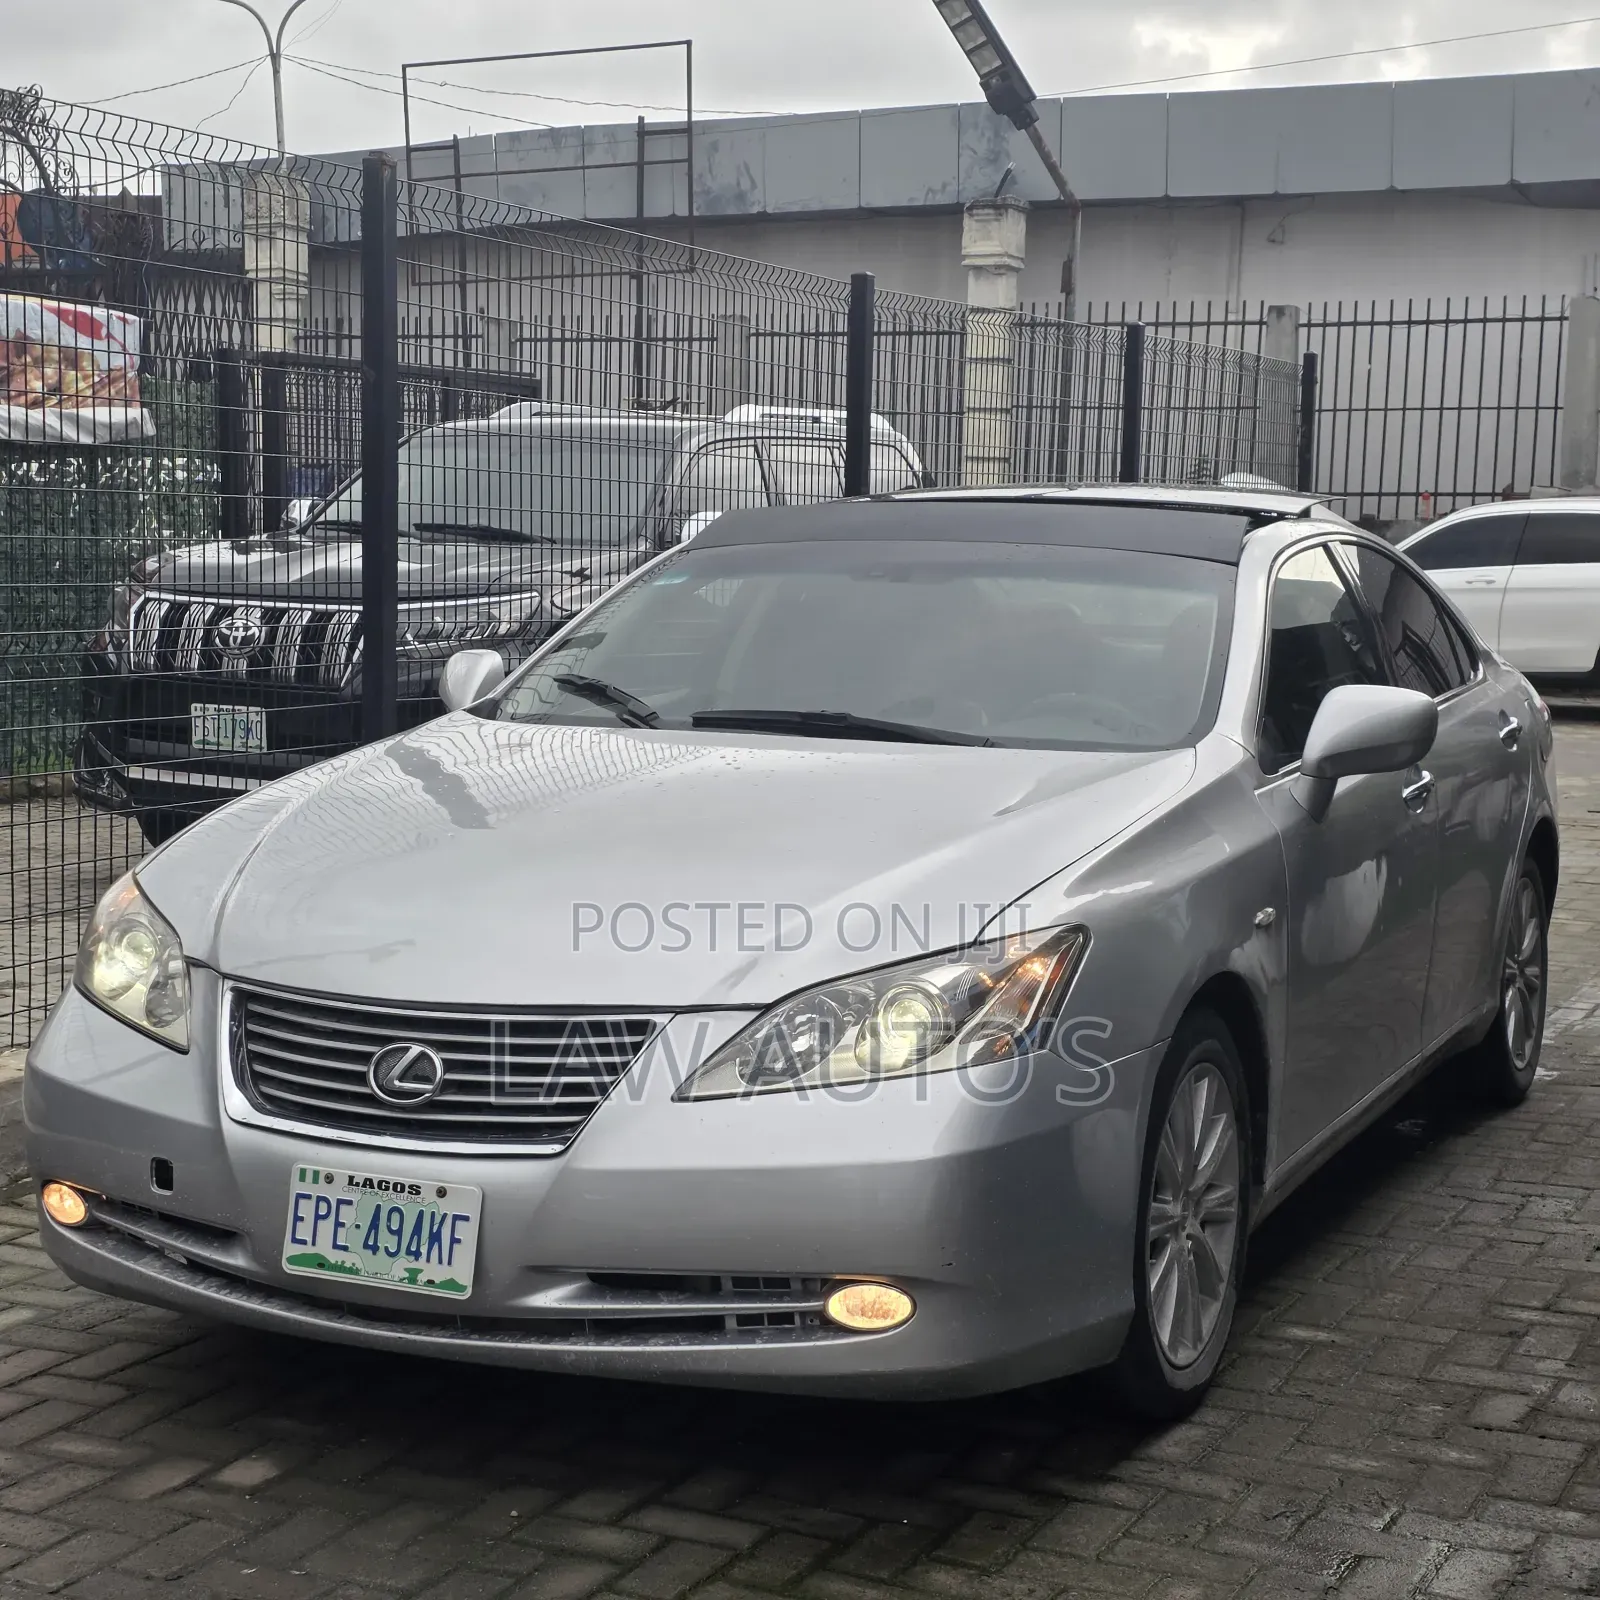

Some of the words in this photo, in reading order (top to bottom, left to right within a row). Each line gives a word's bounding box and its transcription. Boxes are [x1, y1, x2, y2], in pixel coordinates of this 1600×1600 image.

[341, 1185, 368, 1196] CENTRE
[381, 1191, 427, 1204] EXCELLENCE
[347, 1174, 422, 1196] LAGOS
